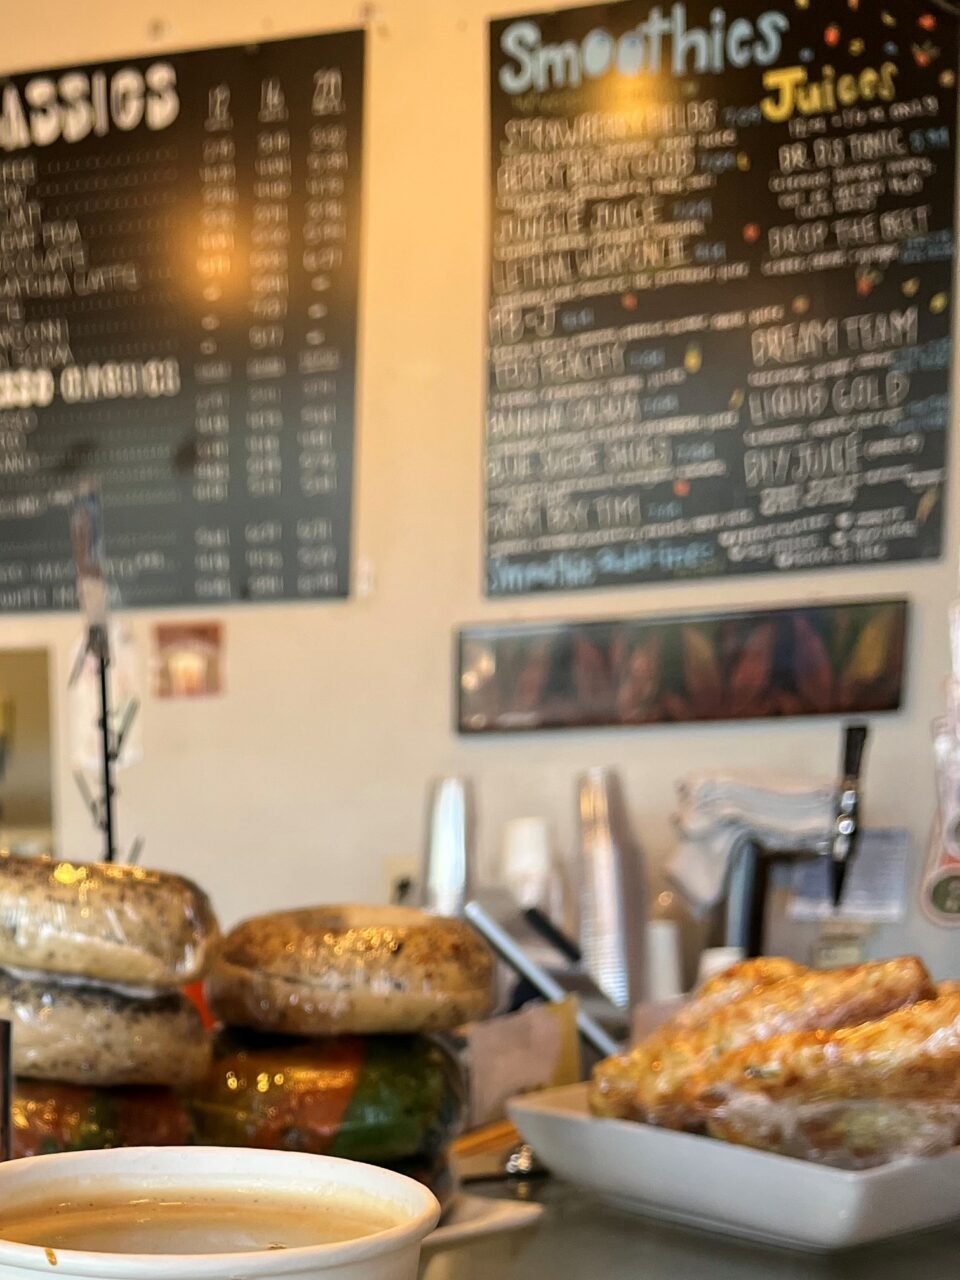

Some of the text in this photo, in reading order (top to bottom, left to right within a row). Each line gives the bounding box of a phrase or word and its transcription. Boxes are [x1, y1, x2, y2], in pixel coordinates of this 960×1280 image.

[499, 2, 790, 94] Smoothies
[760, 61, 898, 122] Juices
[844, 306, 918, 349] TEAM
